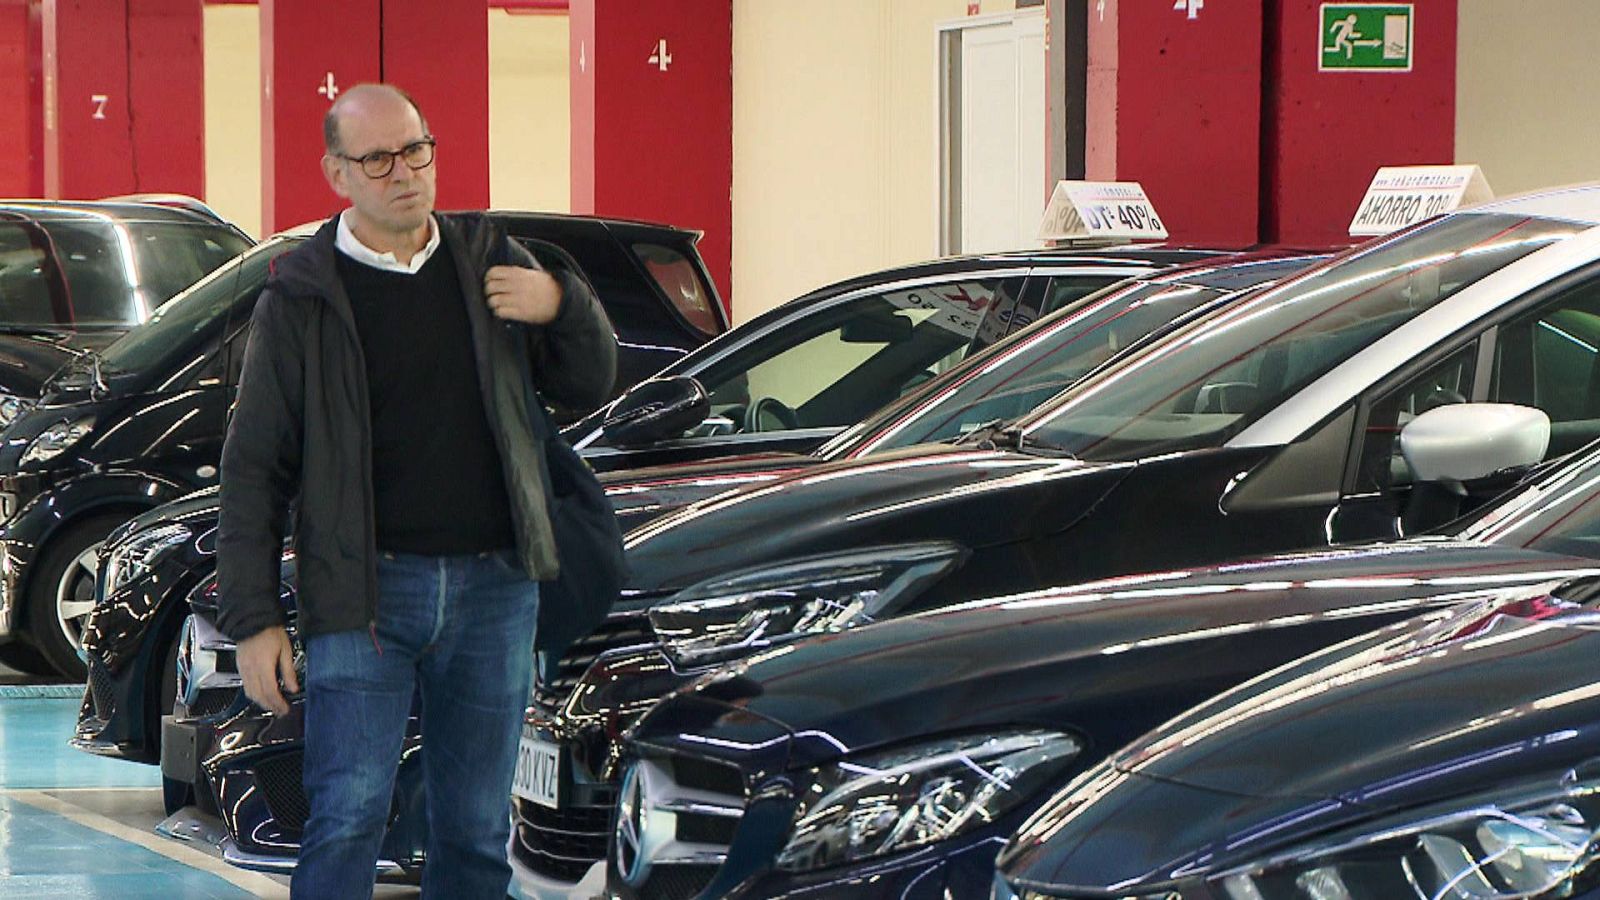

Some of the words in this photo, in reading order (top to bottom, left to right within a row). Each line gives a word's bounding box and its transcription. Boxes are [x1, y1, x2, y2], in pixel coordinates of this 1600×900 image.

[647, 39, 673, 72] 4
[317, 71, 339, 100] 4
[91, 94, 109, 120] 7
[1117, 203, 1161, 232] 40%
[1356, 194, 1422, 226] AHORRO
